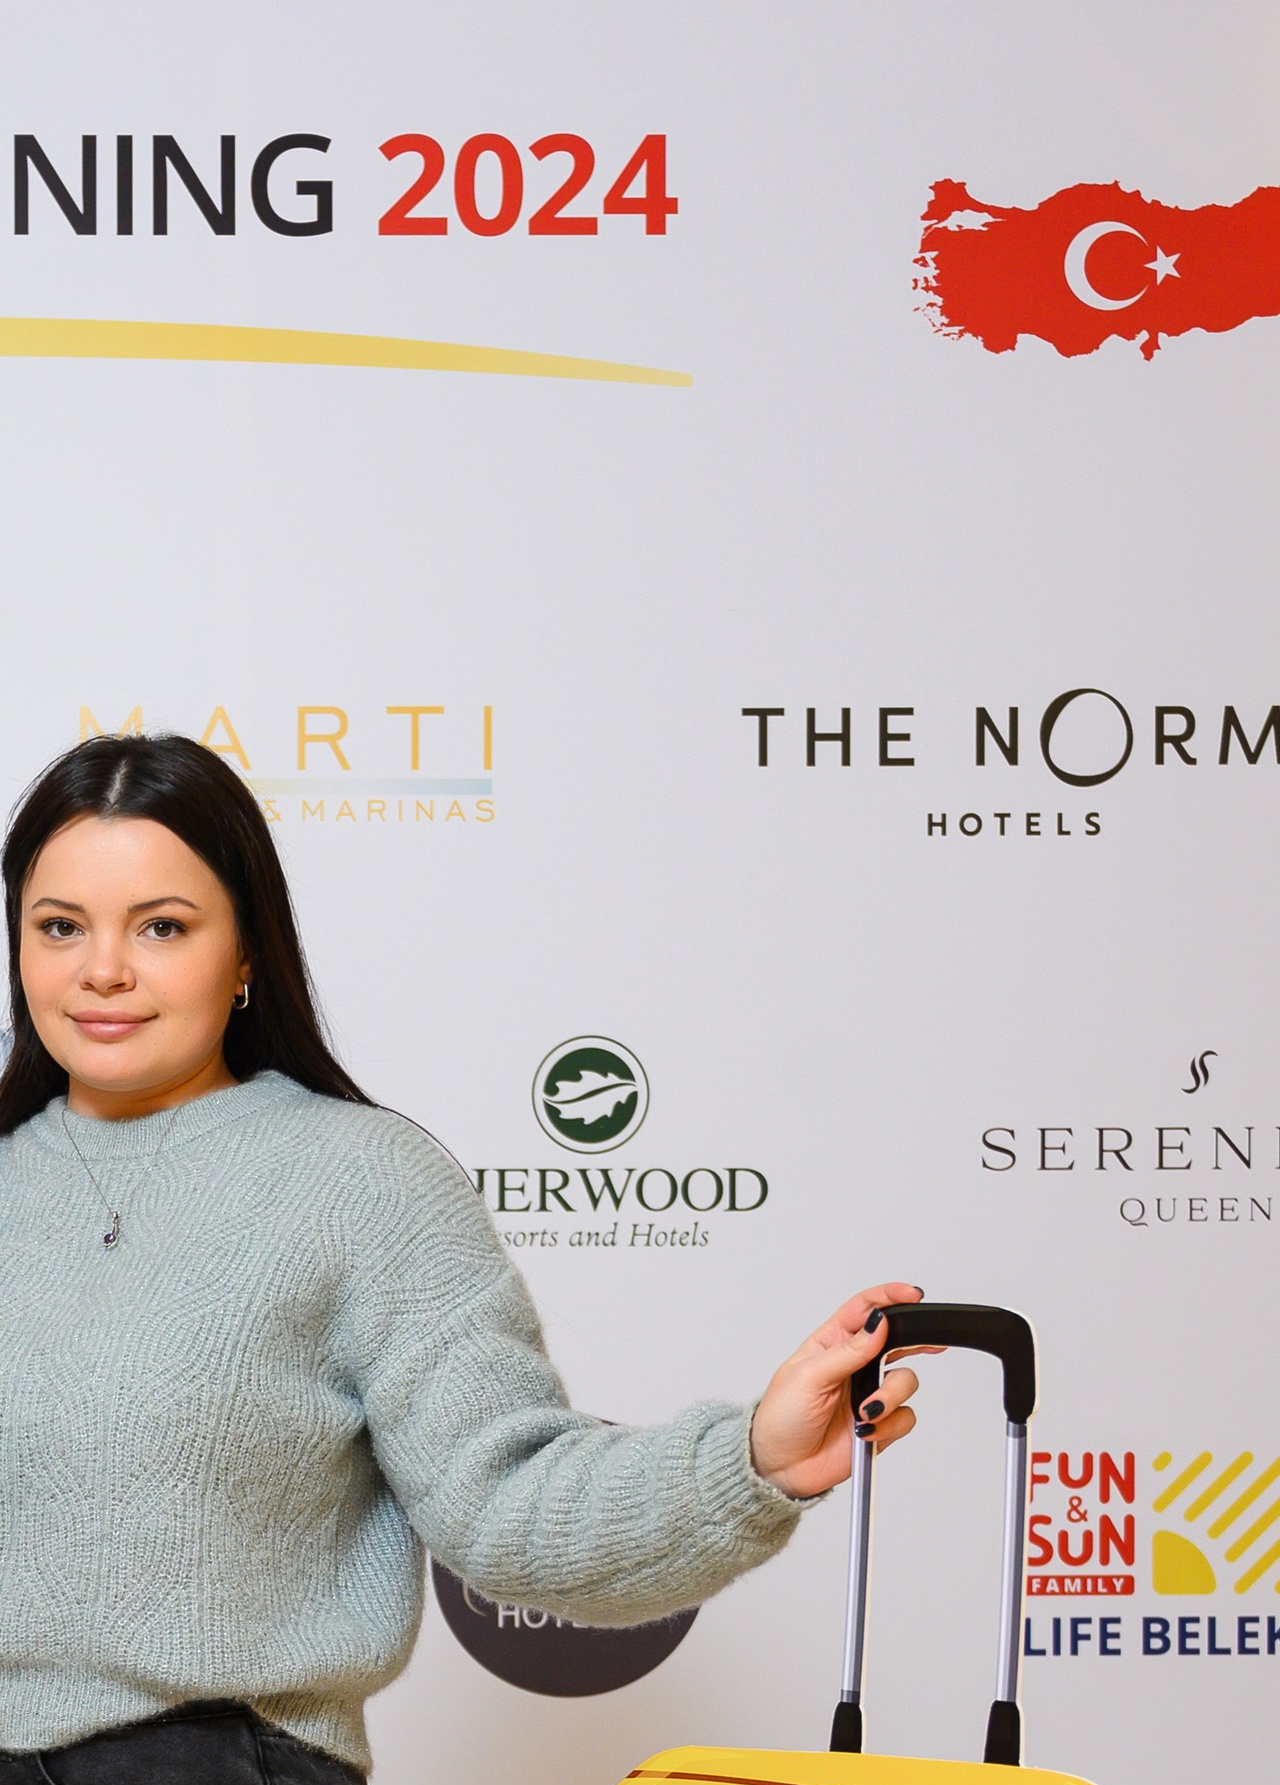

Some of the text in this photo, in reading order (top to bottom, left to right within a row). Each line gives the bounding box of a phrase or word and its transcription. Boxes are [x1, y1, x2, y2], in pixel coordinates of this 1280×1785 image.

[377, 133, 680, 237] 2024
[741, 688, 1280, 787] THE NORM
[302, 799, 496, 823] MARINAS
[926, 812, 1102, 837] HOTELS
[1120, 1198, 1272, 1227] QUEEN
[569, 1222, 618, 1247] and
[631, 1222, 710, 1247] Hotels
[1030, 1451, 1136, 1504] FUN
[1066, 1495, 1088, 1523] &
[1030, 1577, 1125, 1594] FAMILY
[1023, 1616, 1122, 1656] LIFE
